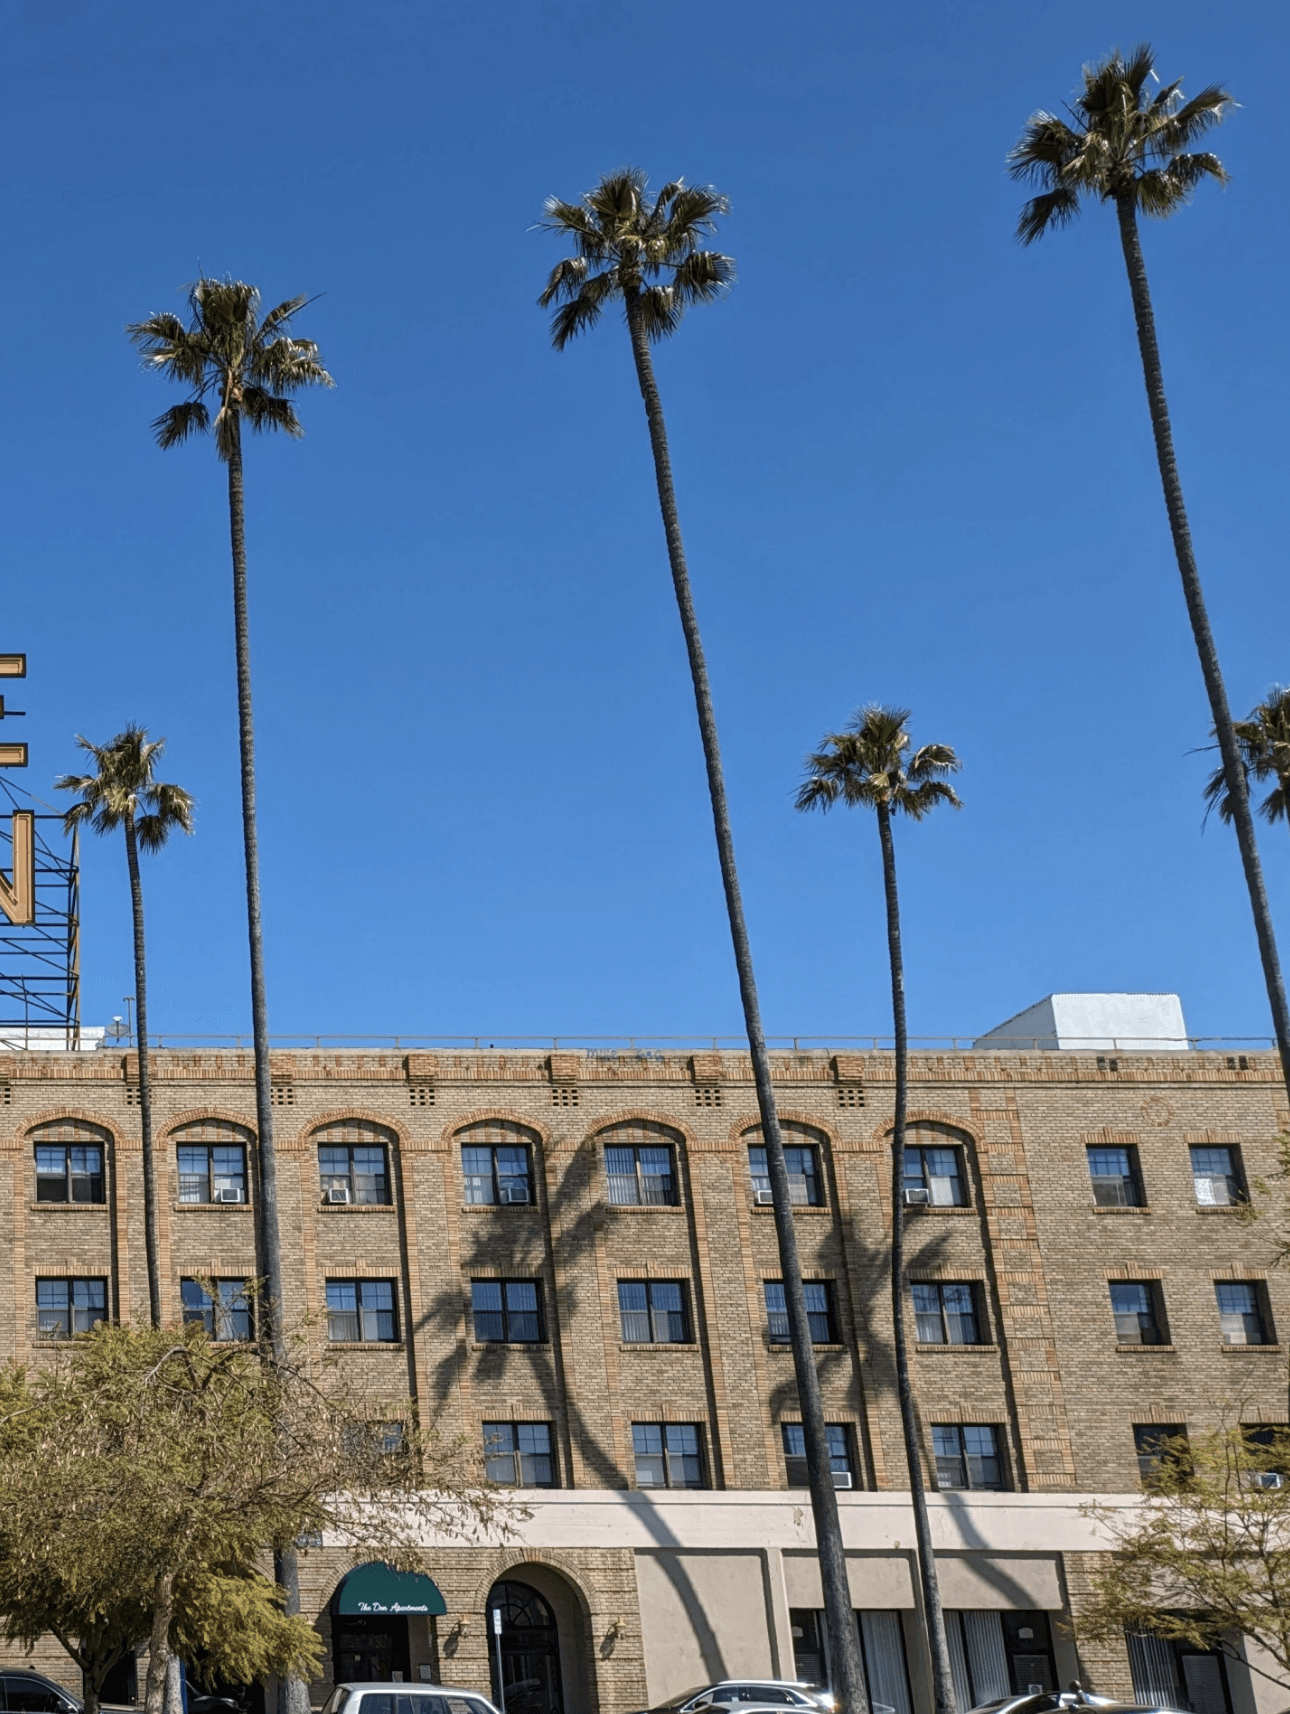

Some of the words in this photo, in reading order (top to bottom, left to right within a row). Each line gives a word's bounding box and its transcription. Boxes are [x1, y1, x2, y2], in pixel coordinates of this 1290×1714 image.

[357, 1602, 371, 1612] The
[372, 1602, 388, 1612] Don
[390, 1602, 429, 1613] Apartments
